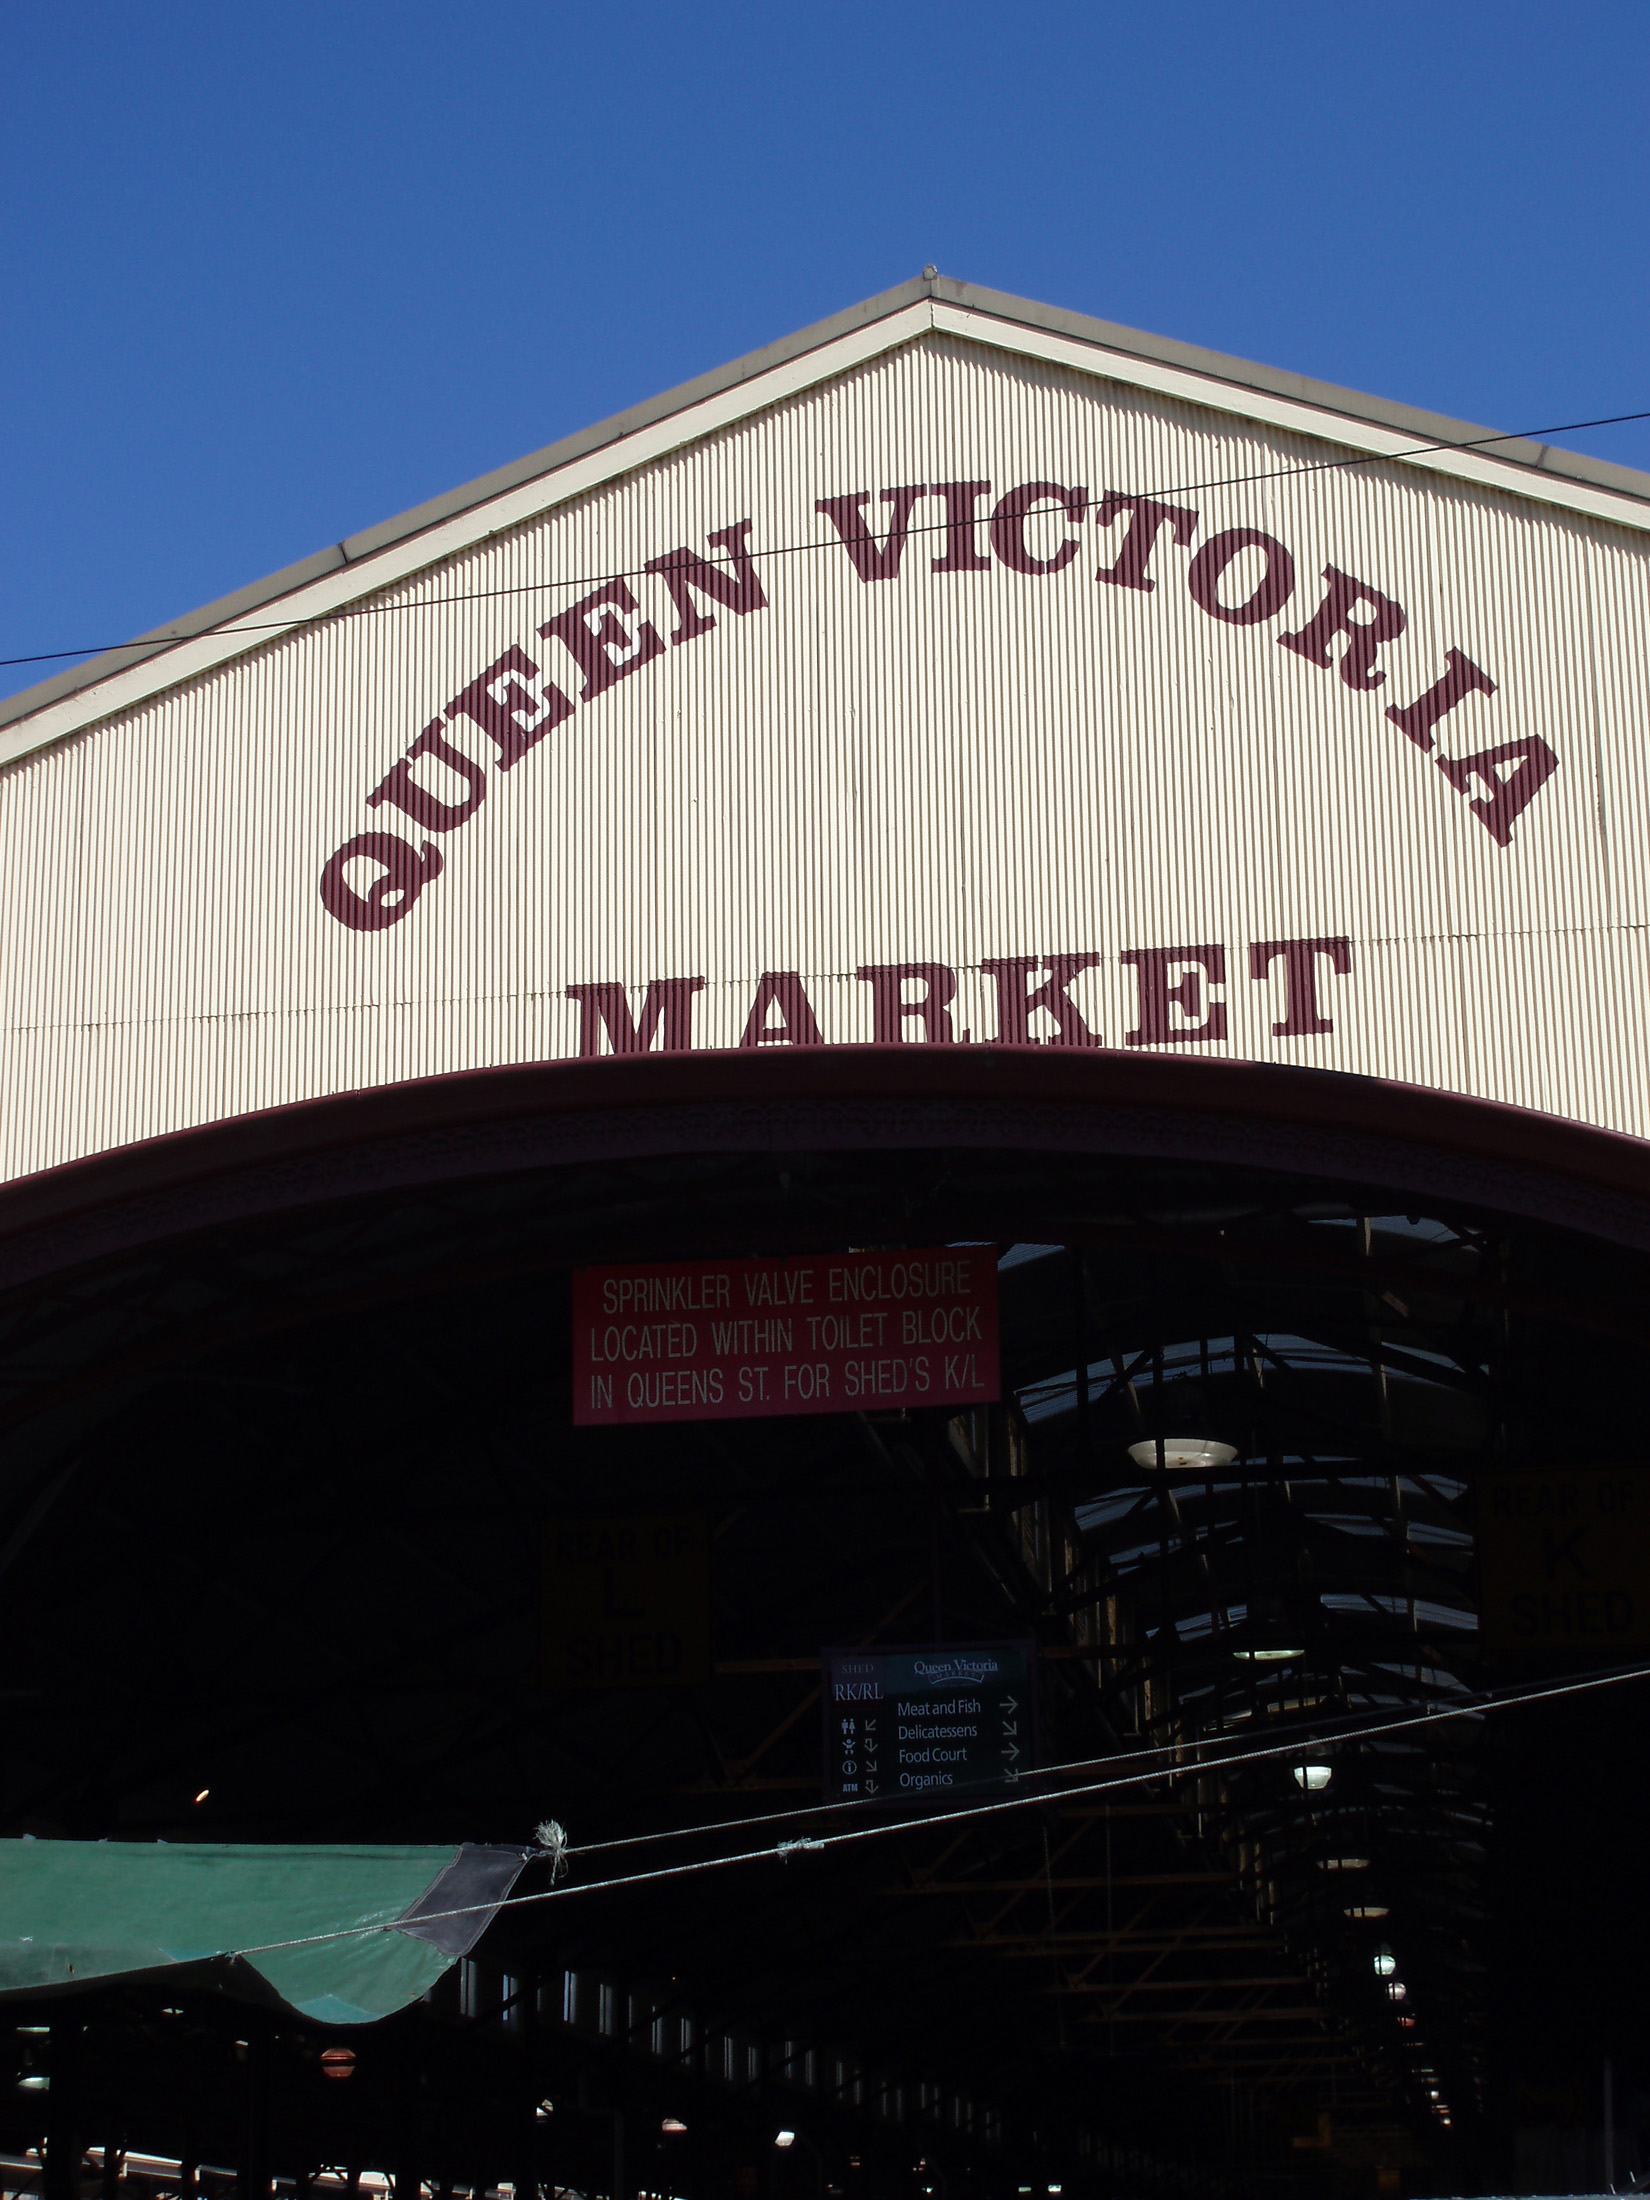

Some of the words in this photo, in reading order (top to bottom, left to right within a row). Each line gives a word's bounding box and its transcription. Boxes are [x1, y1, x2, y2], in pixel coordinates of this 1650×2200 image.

[320, 518, 768, 932] QUEEN
[815, 480, 1559, 847] VICTORIA
[566, 936, 1352, 1057] MARKET
[602, 1274, 731, 1314] SPRINKLER
[745, 1270, 814, 1306] VALVE
[828, 1260, 971, 1303] ENCLOSURE
[591, 1322, 698, 1362] LOCATED
[711, 1318, 793, 1355] WITHIN
[806, 1312, 888, 1350] TOILET
[902, 1306, 982, 1345] BLOCK
[591, 1374, 613, 1409] IN
[627, 1367, 724, 1407] QUEENS
[738, 1366, 770, 1402] ST.
[784, 1363, 830, 1400] FOR
[844, 1356, 930, 1396] SHED'S
[945, 1354, 985, 1390] K/L
[1491, 1482, 1580, 1518] REAR
[1597, 1479, 1634, 1513] OF
[555, 1528, 638, 1563] REAR
[1544, 1526, 1592, 1581] K
[604, 1566, 645, 1620] L
[1511, 1590, 1634, 1638] SHED
[566, 1631, 682, 1678] SHED
[841, 1663, 874, 1675] SHED
[914, 1660, 952, 1675] Queen
[953, 1658, 999, 1672] Victoria
[834, 1682, 884, 1701] RK/RL
[897, 1702, 930, 1717] Meat
[934, 1699, 956, 1715] and
[958, 1699, 981, 1715] Fish
[898, 1724, 978, 1740] Delicatessens
[899, 1748, 930, 1764] Food
[932, 1747, 968, 1763] Court
[842, 1783, 858, 1792] ATM
[899, 1770, 954, 1790] Organics
